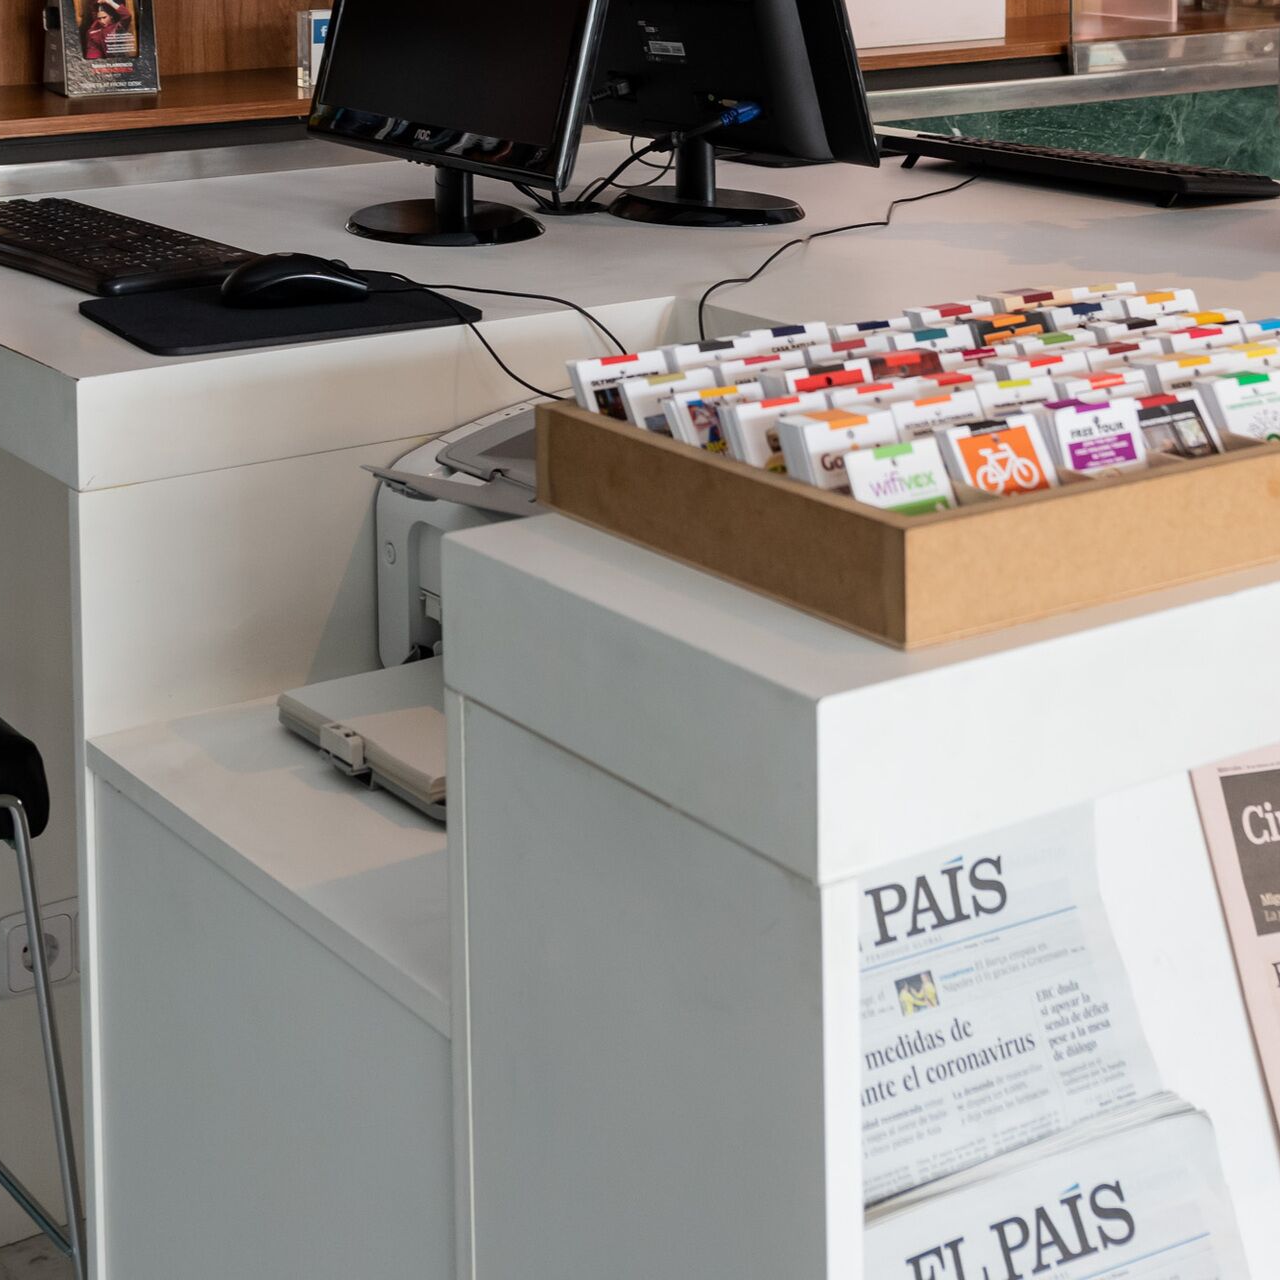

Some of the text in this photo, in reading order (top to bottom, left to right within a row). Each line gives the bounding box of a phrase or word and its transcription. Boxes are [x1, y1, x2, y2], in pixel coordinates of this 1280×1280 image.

[414, 129, 431, 141] AOC
[864, 854, 1008, 947] PAÍS
[865, 1017, 974, 1071] medidas de
[902, 1065, 921, 1092] el
[926, 1032, 1036, 1084] coronavirus
[989, 1180, 1136, 1280] PAÍS
